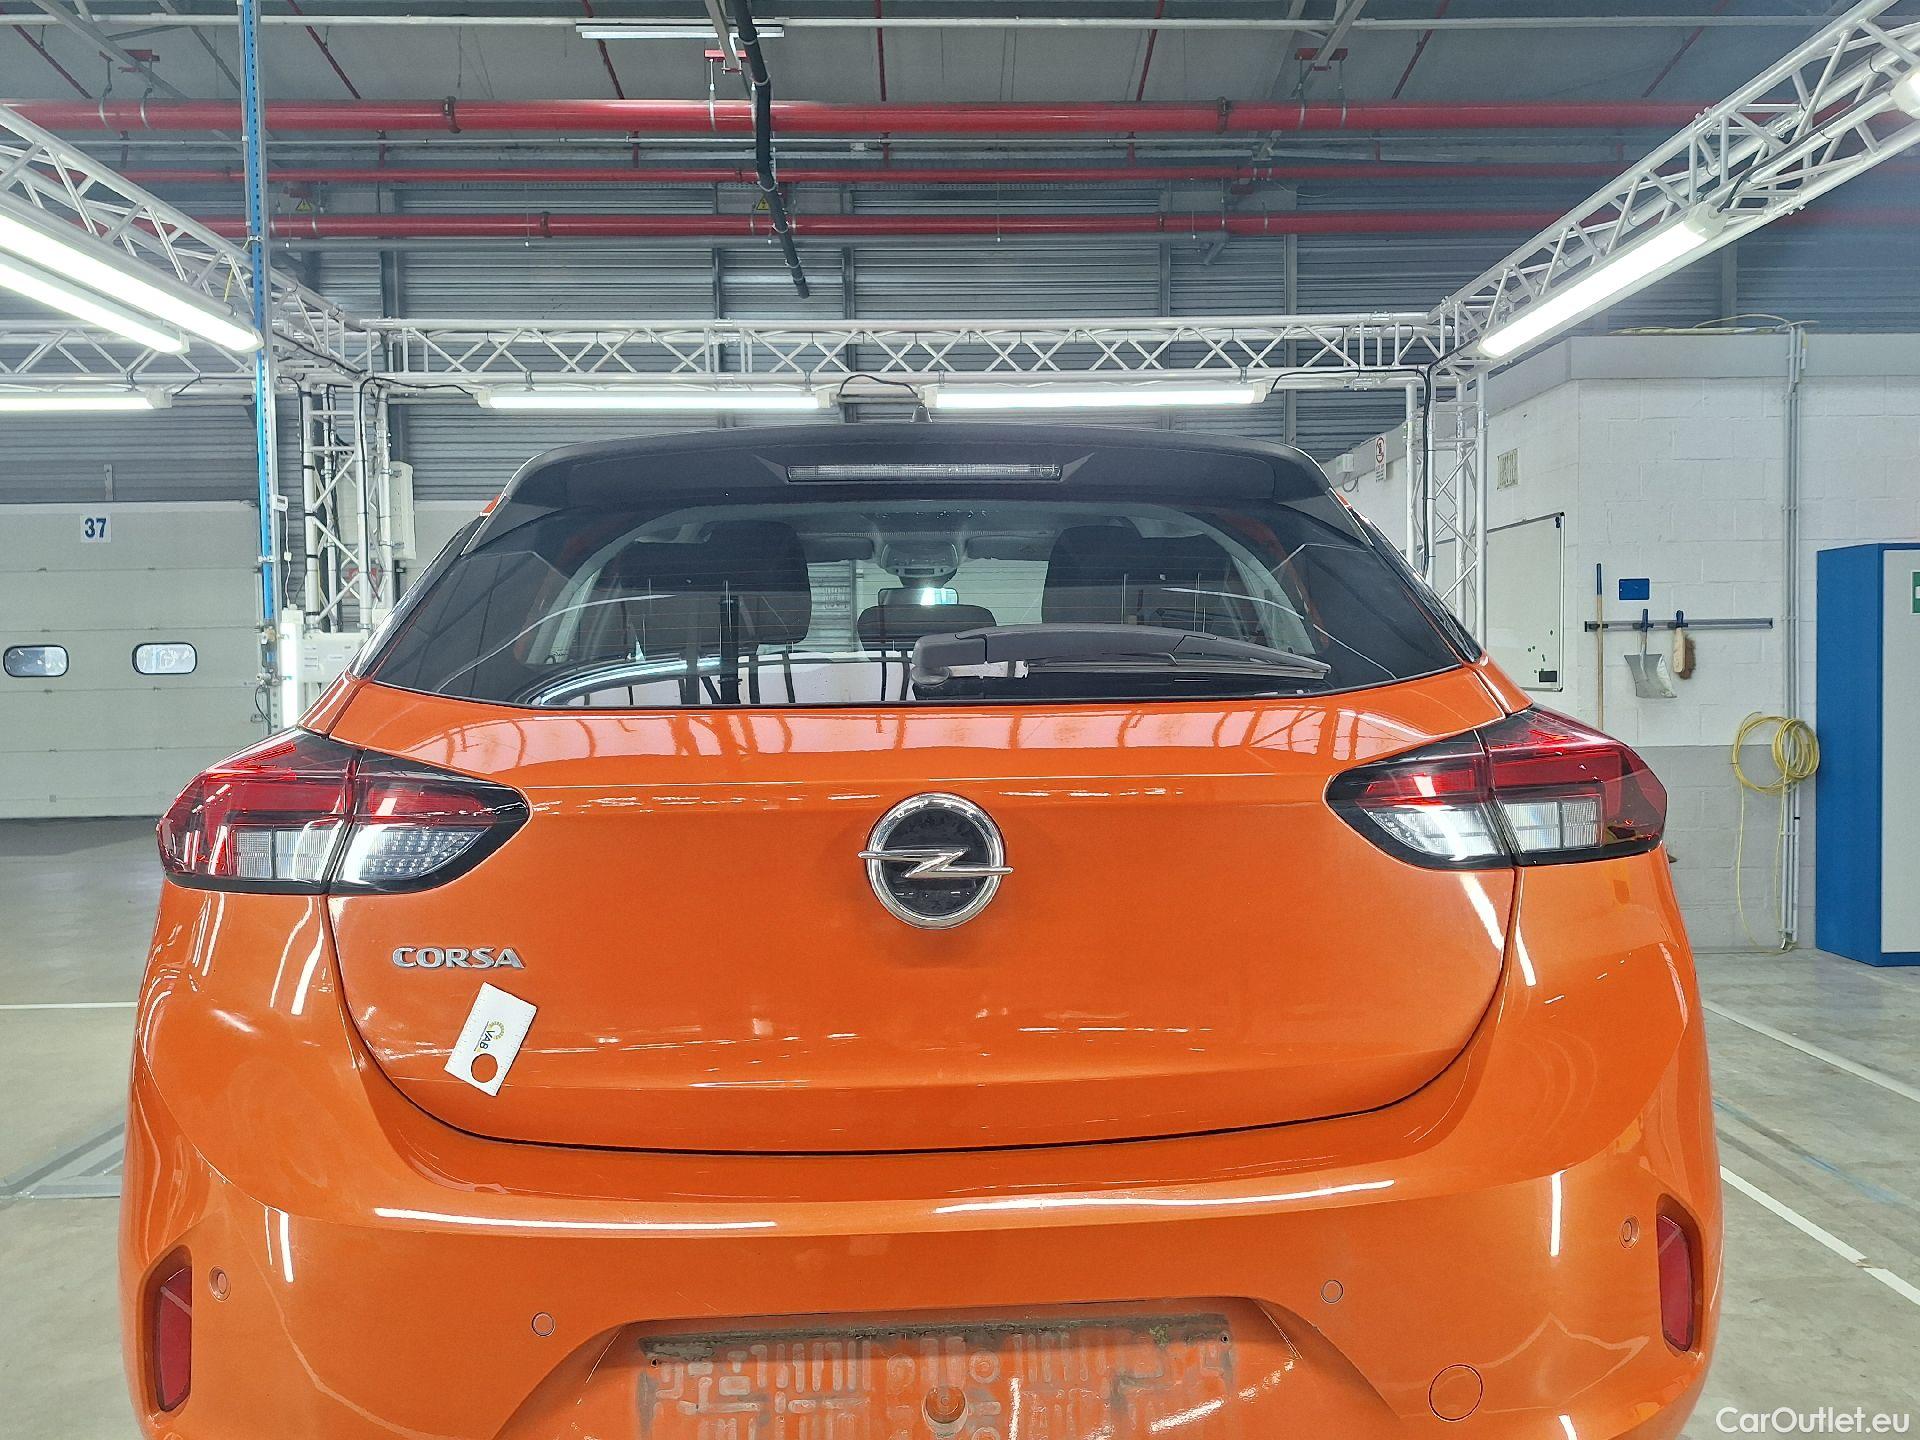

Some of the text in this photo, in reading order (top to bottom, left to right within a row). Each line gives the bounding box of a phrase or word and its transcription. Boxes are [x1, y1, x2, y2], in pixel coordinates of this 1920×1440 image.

[84, 517, 107, 539] 37
[392, 946, 525, 970] CORSA
[479, 1030, 496, 1050] VAB
